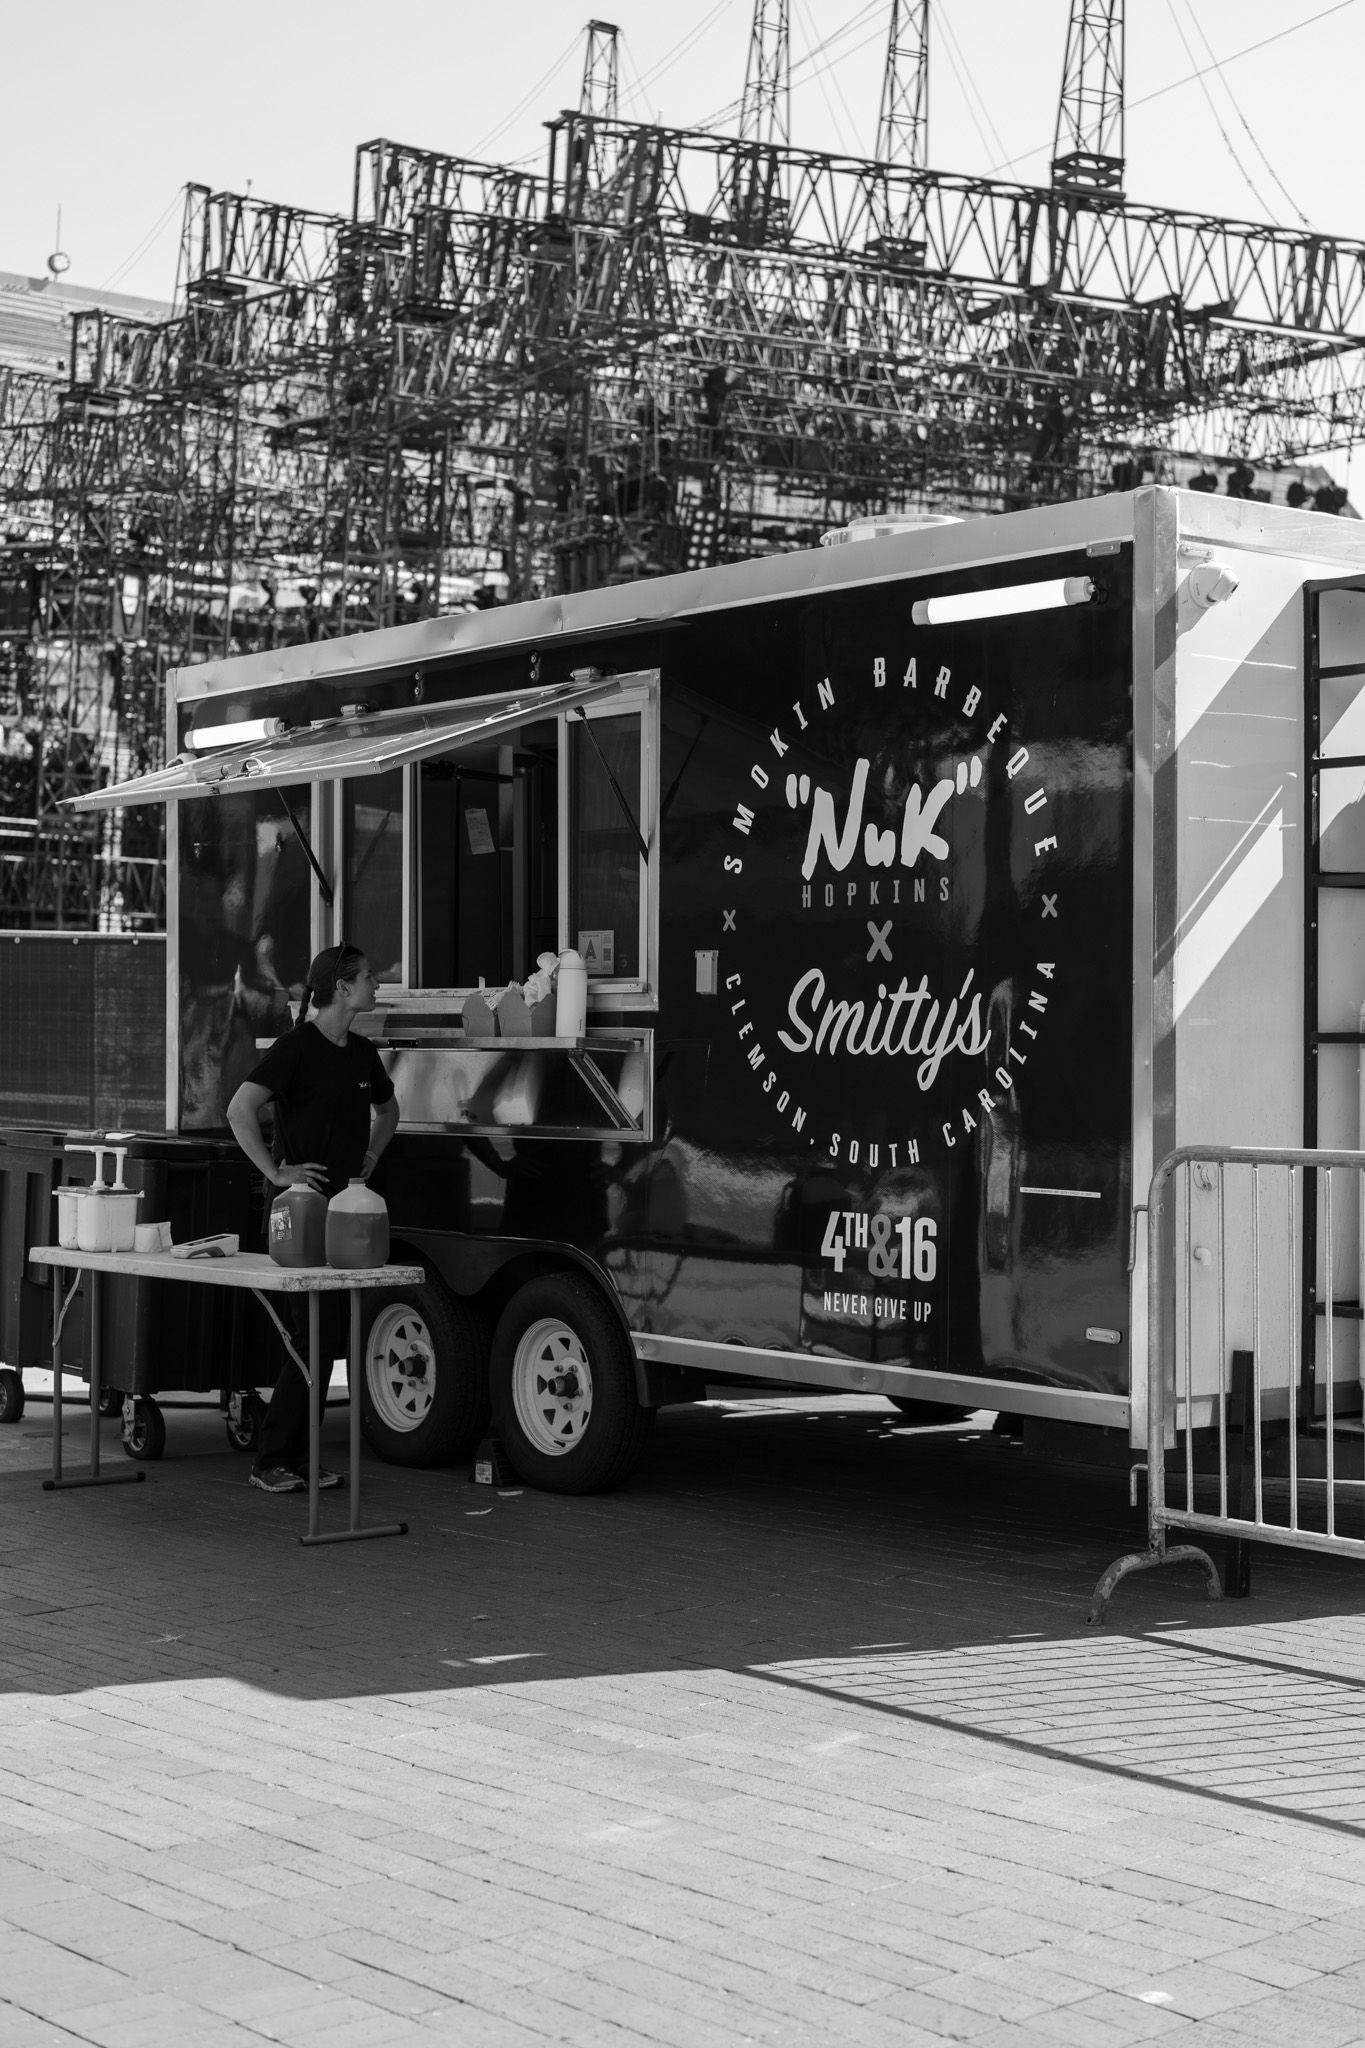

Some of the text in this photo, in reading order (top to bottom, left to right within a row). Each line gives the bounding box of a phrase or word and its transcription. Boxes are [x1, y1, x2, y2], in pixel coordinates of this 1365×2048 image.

[723, 657, 1058, 874] SMOKIN BARBEQUE
[802, 877, 950, 908] HOPKINS
[584, 939, 597, 960] A
[777, 968, 992, 1091] Smitty's
[829, 1133, 920, 1168] SOUTH
[942, 961, 1056, 1147] CAROLINA
[823, 1291, 932, 1323] NEVER GIVE UP
